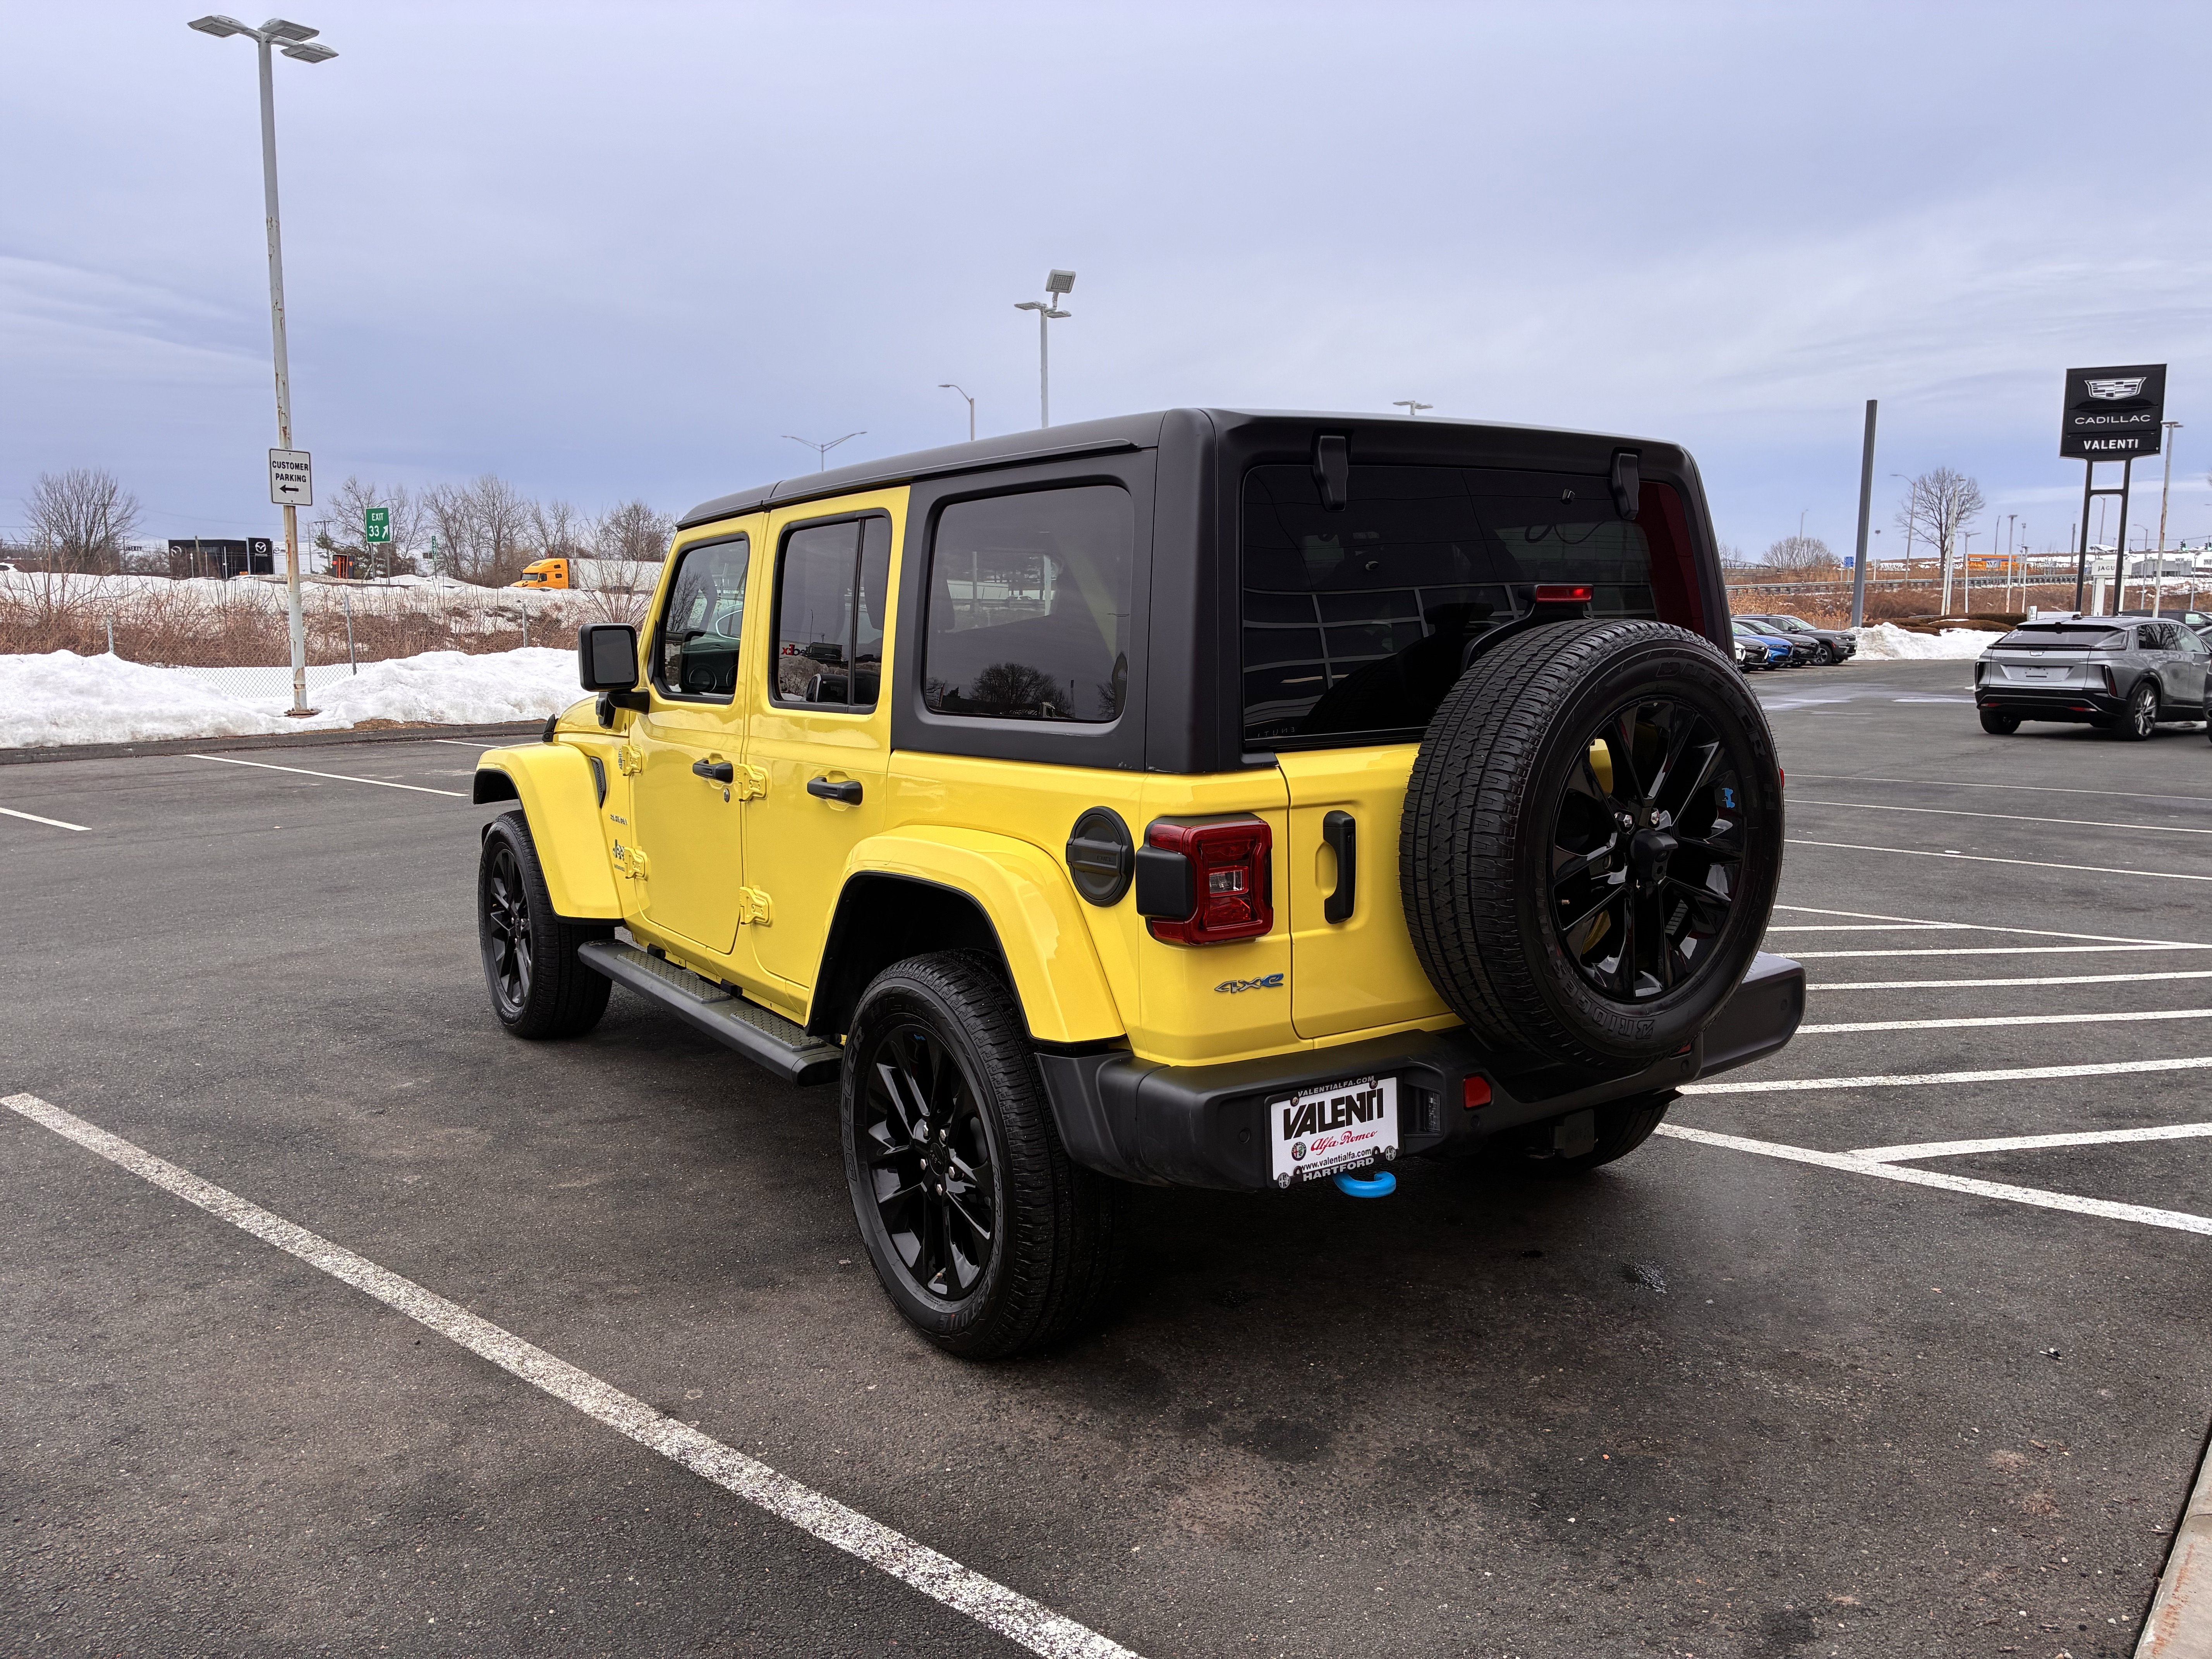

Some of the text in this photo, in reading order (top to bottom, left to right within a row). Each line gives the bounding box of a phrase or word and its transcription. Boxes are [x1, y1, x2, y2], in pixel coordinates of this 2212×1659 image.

[2075, 414, 2151, 425] CADILLAC
[2083, 439, 2139, 450] VALENTI
[272, 460, 309, 471] CUSTOMER
[275, 473, 306, 483] PARKING
[371, 513, 384, 521] EXIT
[369, 525, 380, 537] 33
[1655, 661, 1767, 758] DUELER
[612, 839, 625, 861] Jee
[1297, 1075, 1374, 1097] VALENTIALFA.COM
[842, 1025, 866, 1182] DUELER
[1283, 1087, 1384, 1141] VALENTI
[1310, 1135, 1339, 1156] Alfa
[1340, 1130, 1378, 1145] Romeo
[1300, 1148, 1372, 1171] www.valentialfa.com
[1303, 1157, 1374, 1182] HARTFORD
